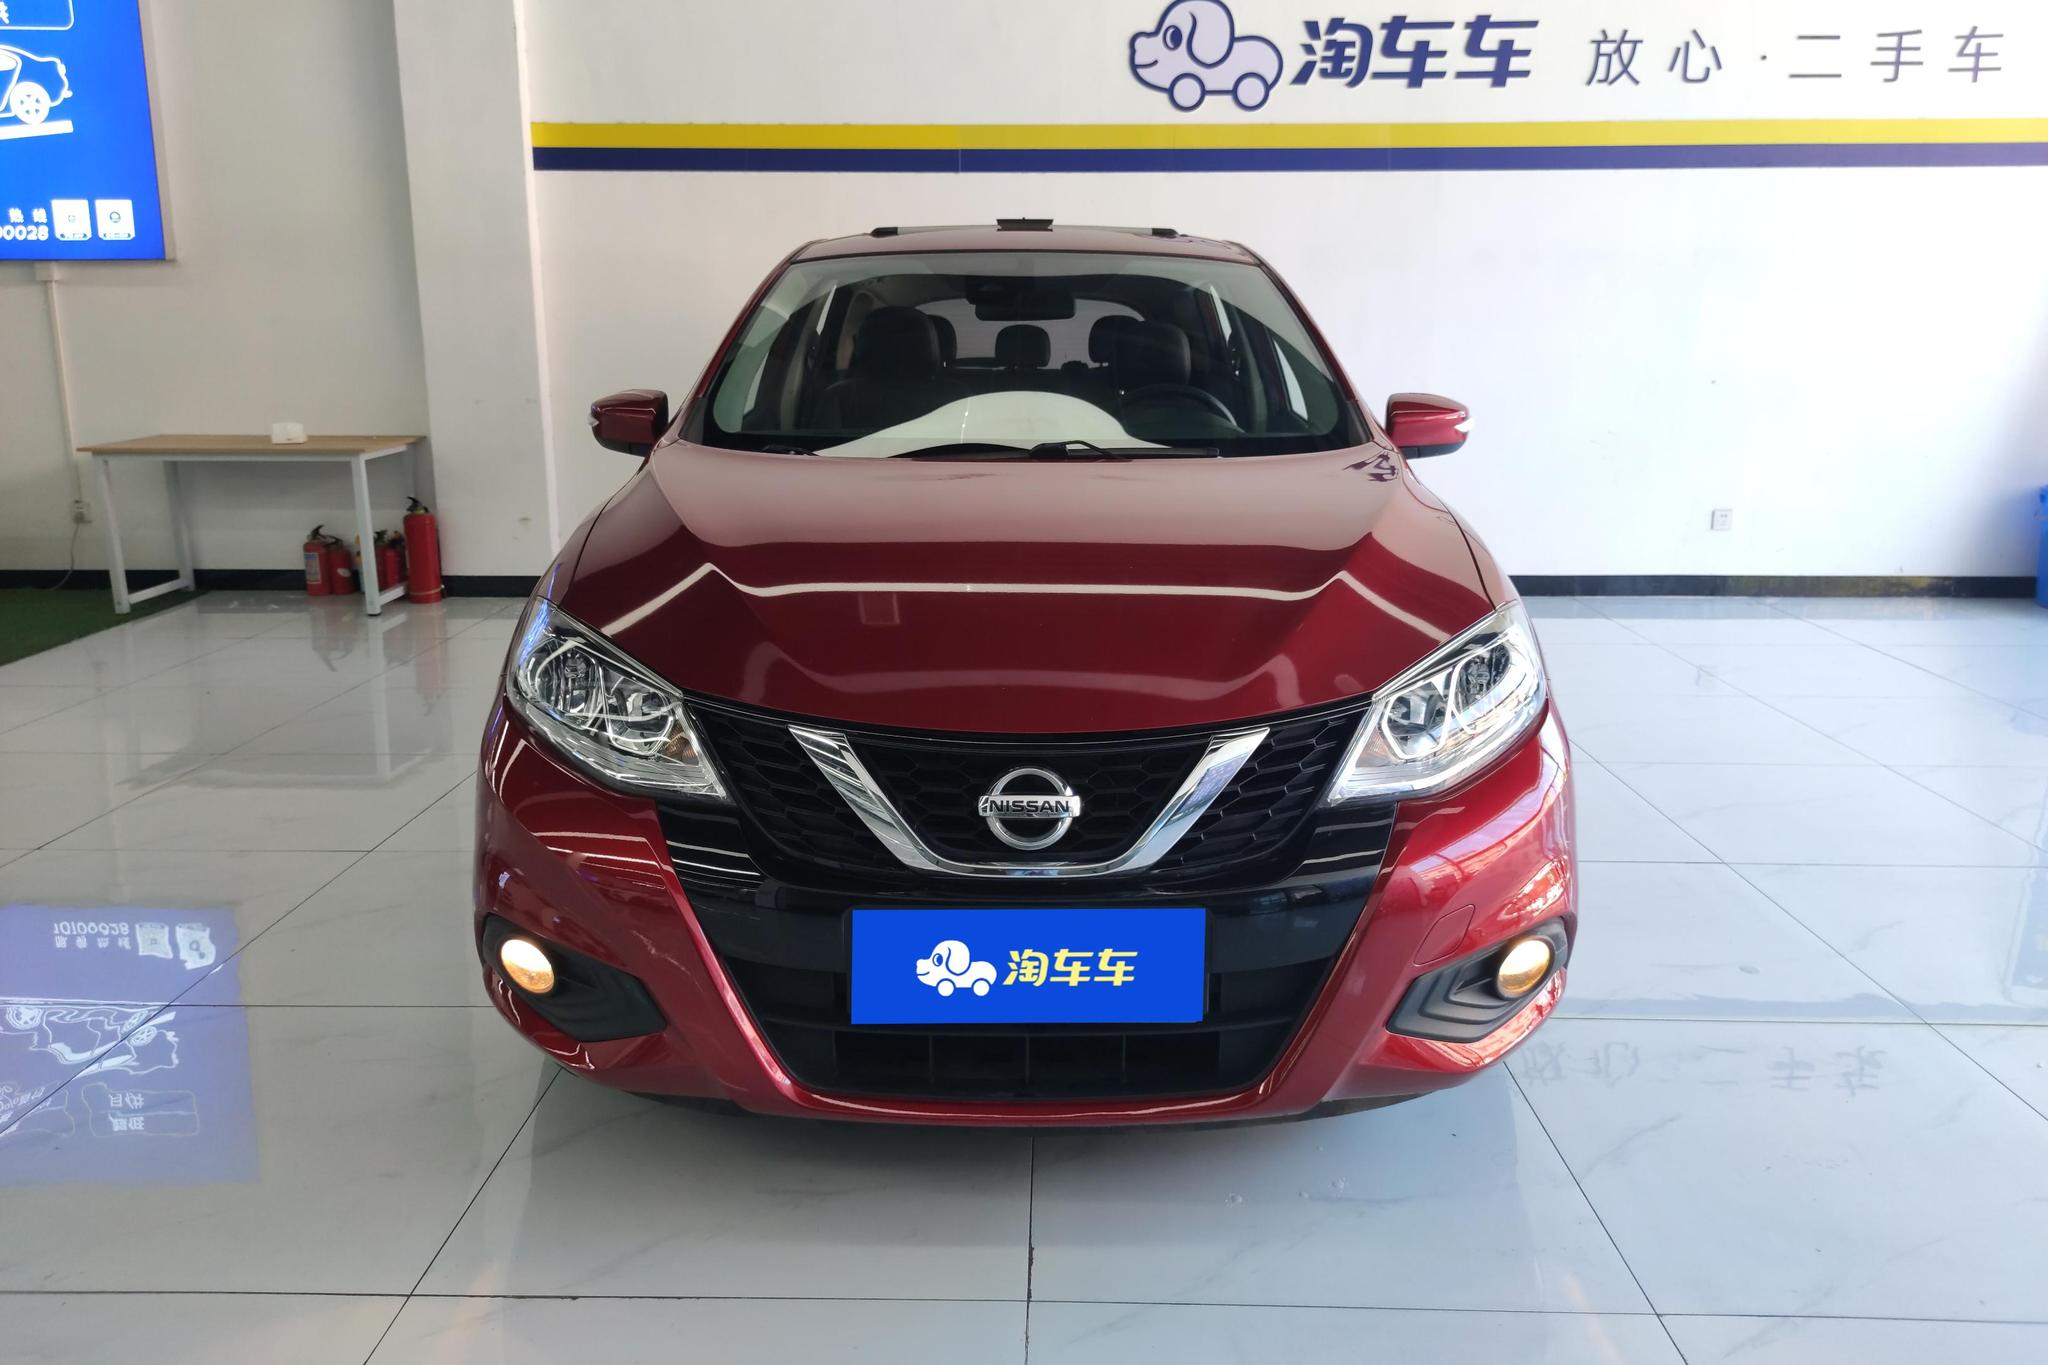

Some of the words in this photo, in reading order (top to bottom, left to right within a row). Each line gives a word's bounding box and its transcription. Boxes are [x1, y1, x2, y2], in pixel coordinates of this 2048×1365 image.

[1289, 14, 1540, 89] 淘车车
[0, 225, 49, 241] 0028
[989, 799, 1070, 813] NISSAN
